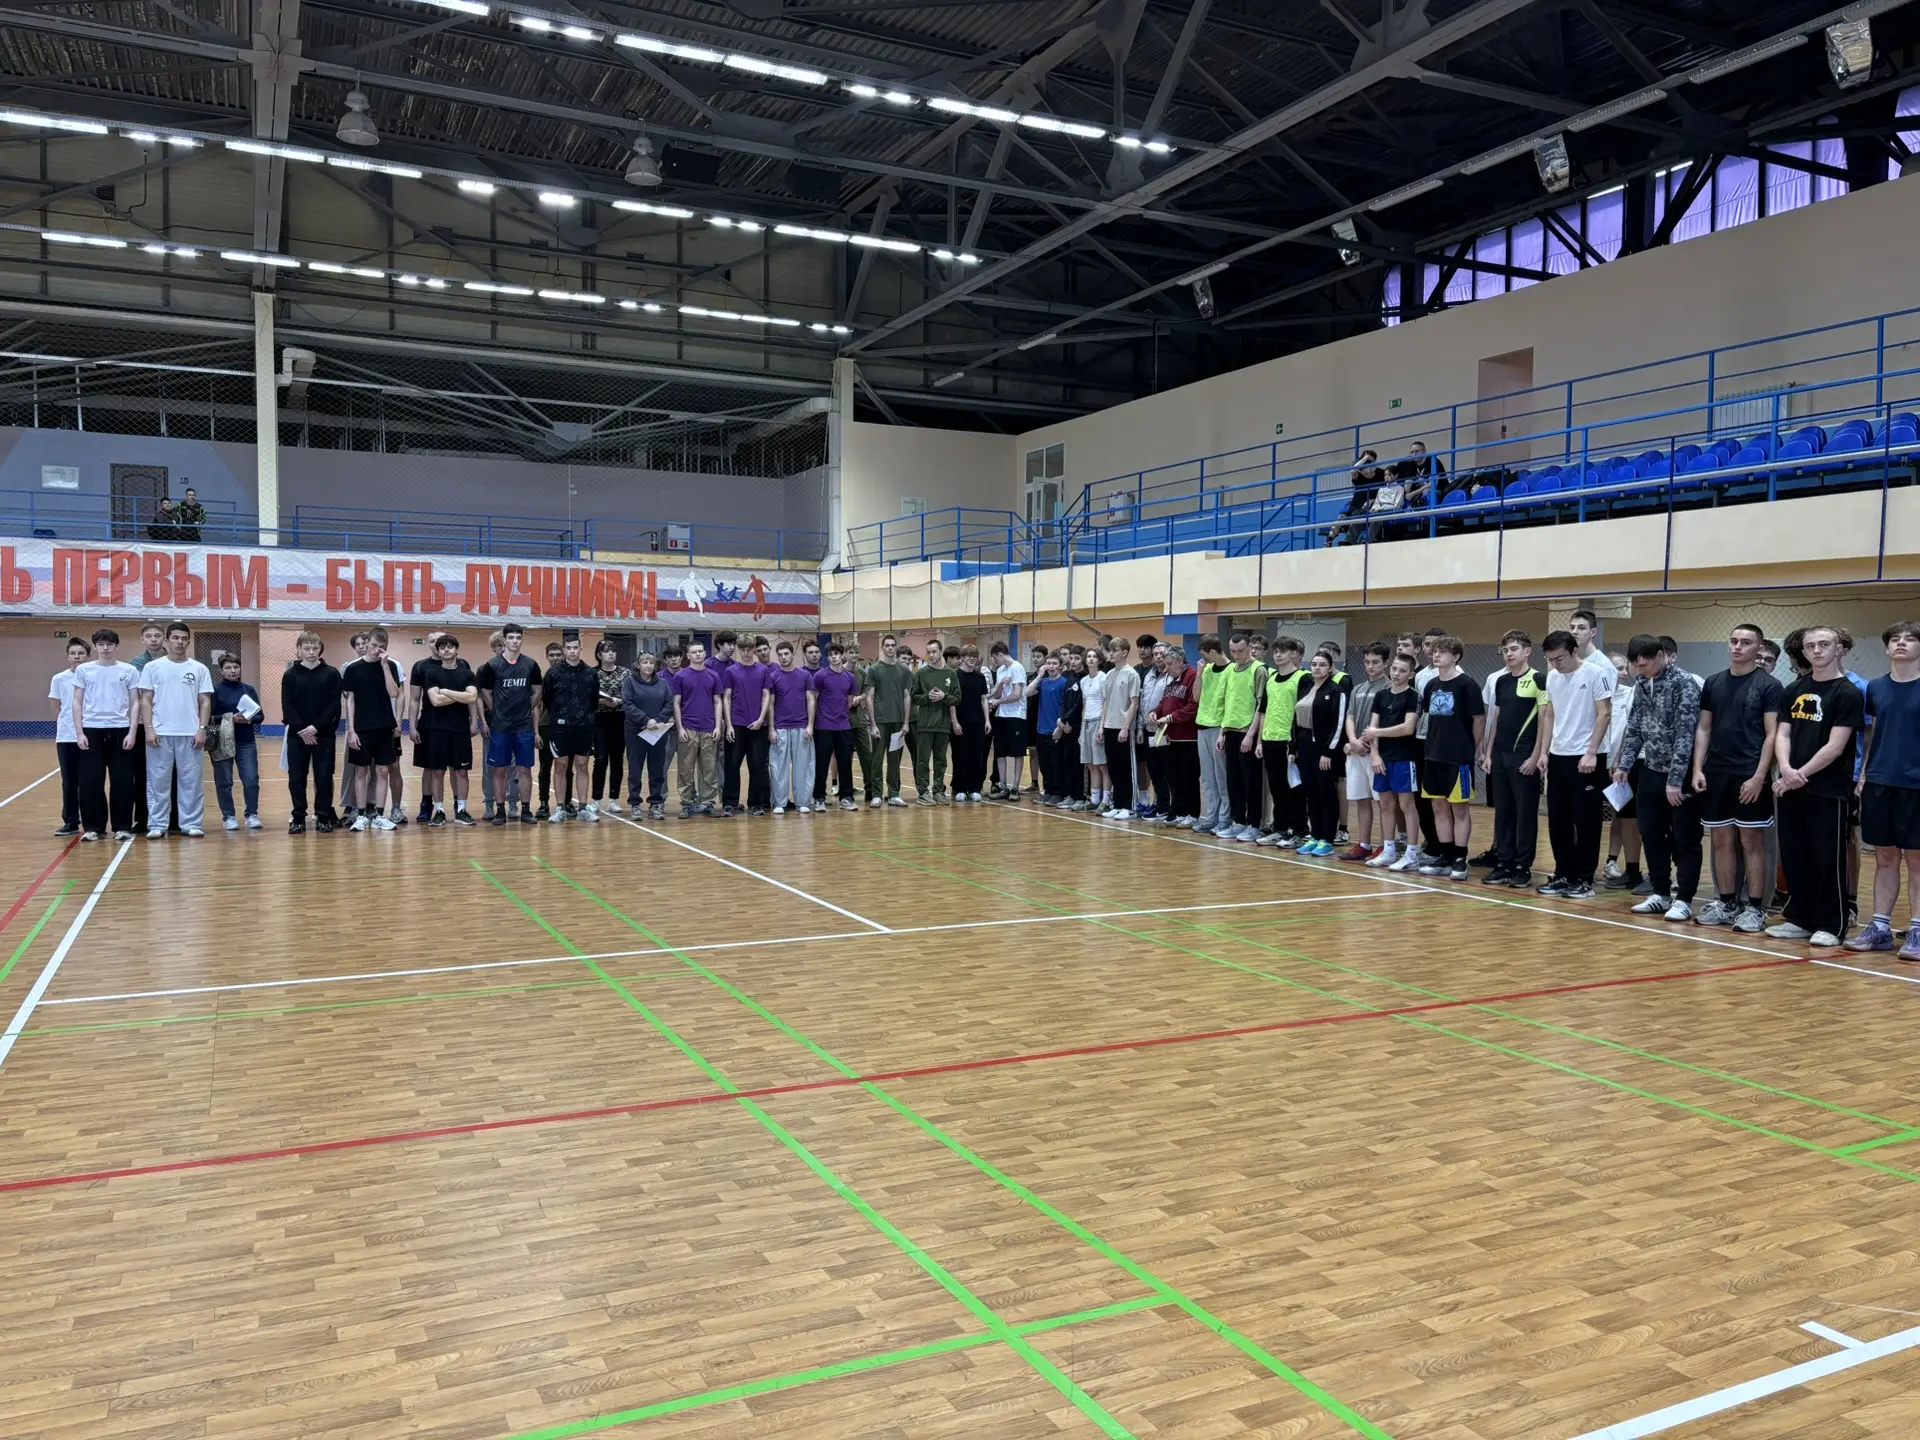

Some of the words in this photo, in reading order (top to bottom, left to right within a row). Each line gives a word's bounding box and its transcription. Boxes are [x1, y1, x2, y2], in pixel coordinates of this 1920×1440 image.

[0, 546, 34, 604] Ь
[52, 547, 270, 610] ПЕРВЫМ
[326, 558, 448, 614] БЫТЬ
[461, 563, 658, 620] ЛУЧШИМ!
[502, 677, 527, 688] ТЕМП
